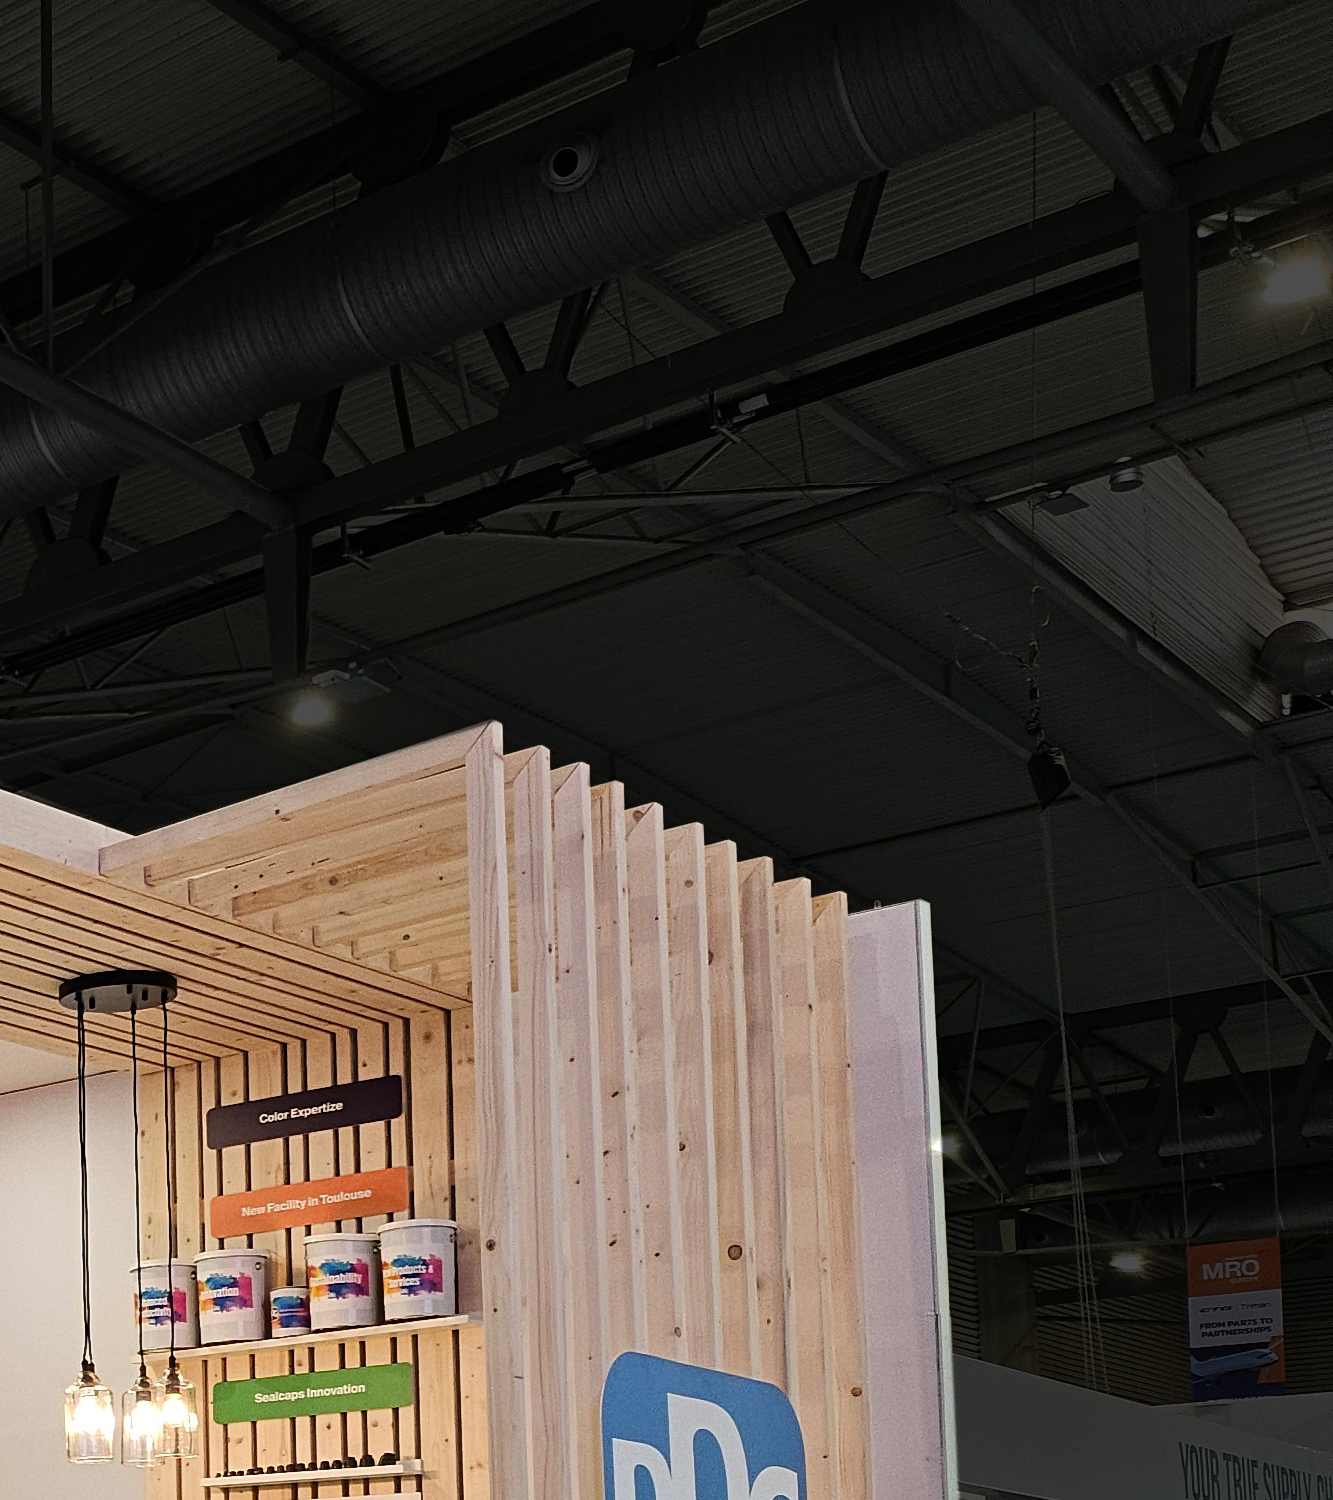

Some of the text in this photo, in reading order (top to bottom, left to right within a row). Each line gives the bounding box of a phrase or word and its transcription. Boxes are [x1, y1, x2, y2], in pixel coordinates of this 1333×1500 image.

[259, 1100, 343, 1124] Color Expertize
[241, 1187, 372, 1218] New Facility in Toulouse
[1202, 1259, 1261, 1280] MRO
[1200, 1317, 1274, 1330] FROM PARTS TO
[1201, 1326, 1273, 1339] PARTNERSHIPS
[254, 1382, 366, 1406] Sealcaps Innovation
